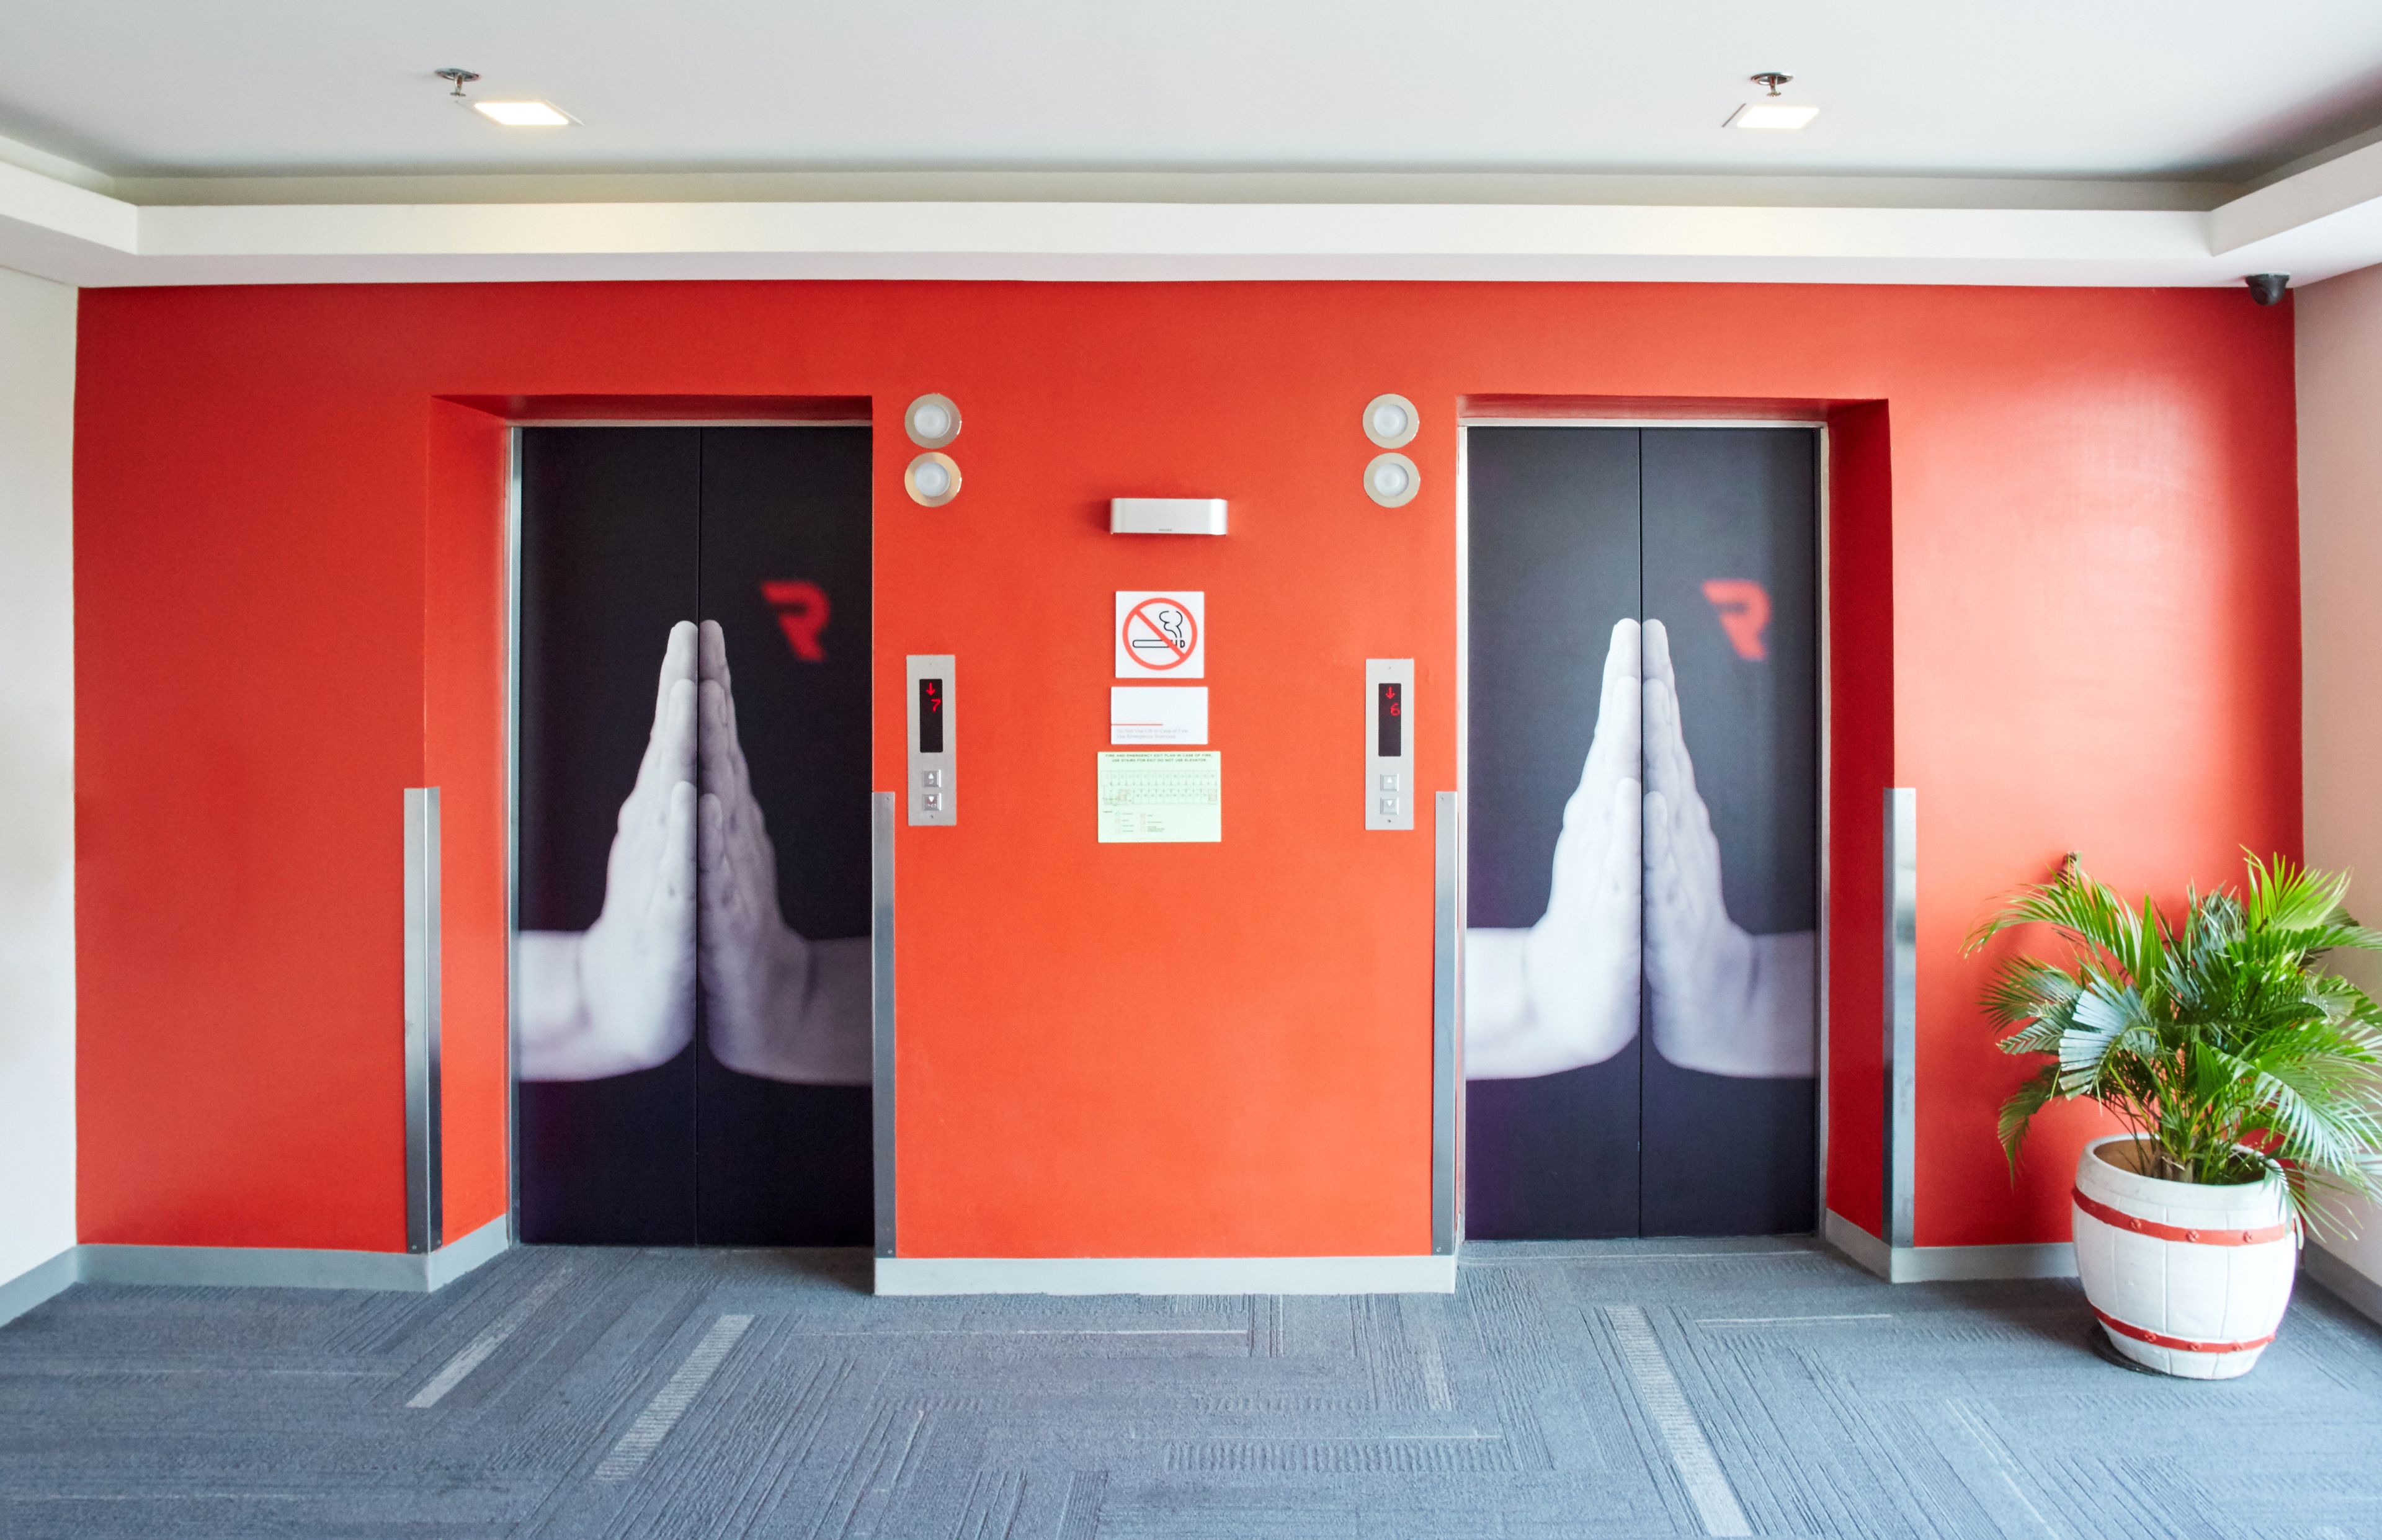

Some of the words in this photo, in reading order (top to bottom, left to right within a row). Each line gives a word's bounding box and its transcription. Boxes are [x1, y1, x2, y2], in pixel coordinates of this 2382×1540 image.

[761, 579, 830, 661] R
[1702, 578, 1772, 660] R
[931, 698, 941, 712] 7
[1391, 703, 1400, 716] 6
